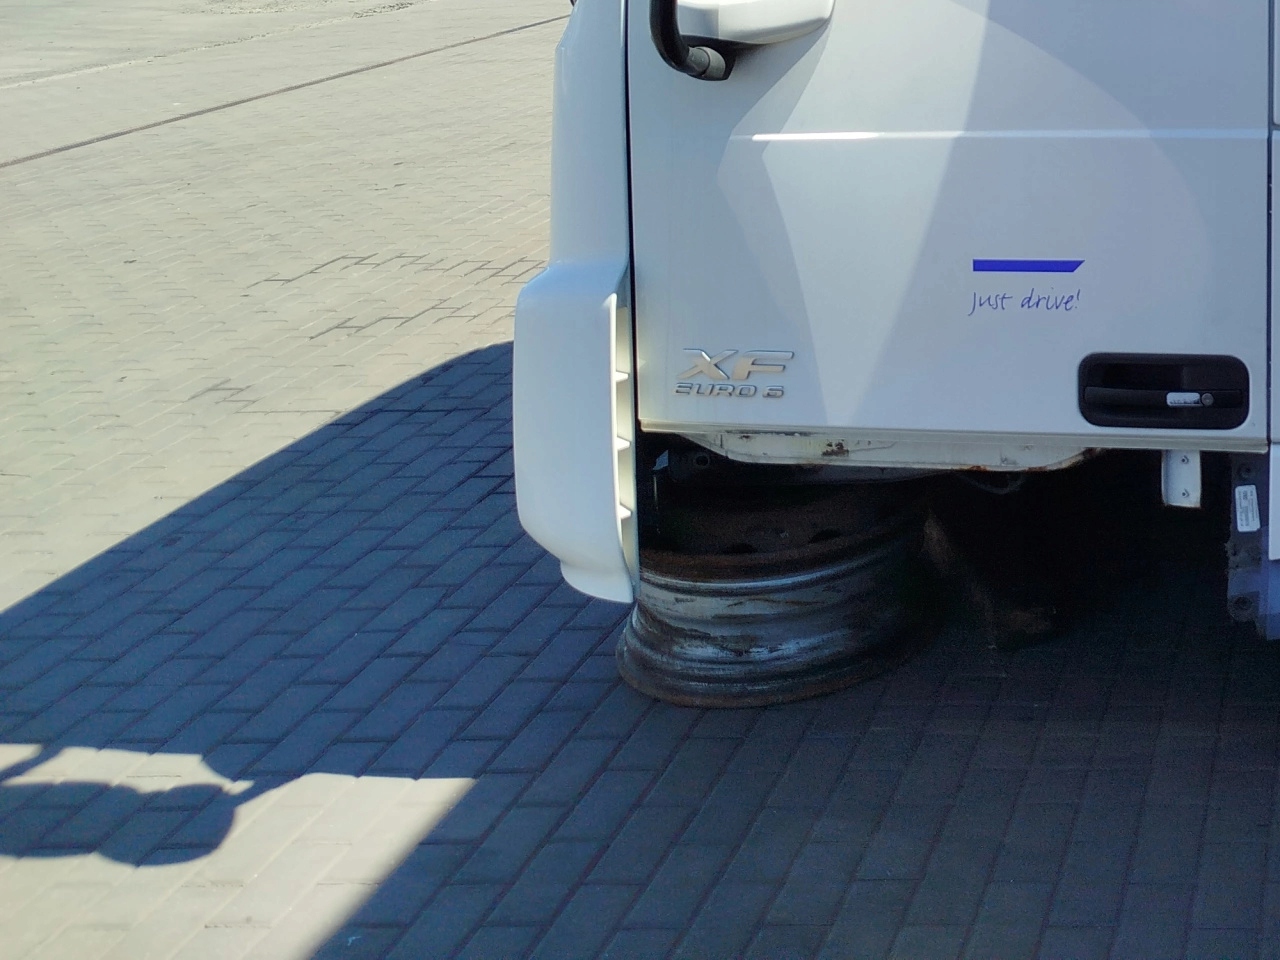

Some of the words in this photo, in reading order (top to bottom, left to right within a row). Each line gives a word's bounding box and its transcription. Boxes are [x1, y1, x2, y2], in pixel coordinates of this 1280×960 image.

[1020, 287, 1081, 311] drive!
[677, 348, 795, 381] XF
[674, 382, 758, 398] EURO
[762, 385, 785, 398] 6
